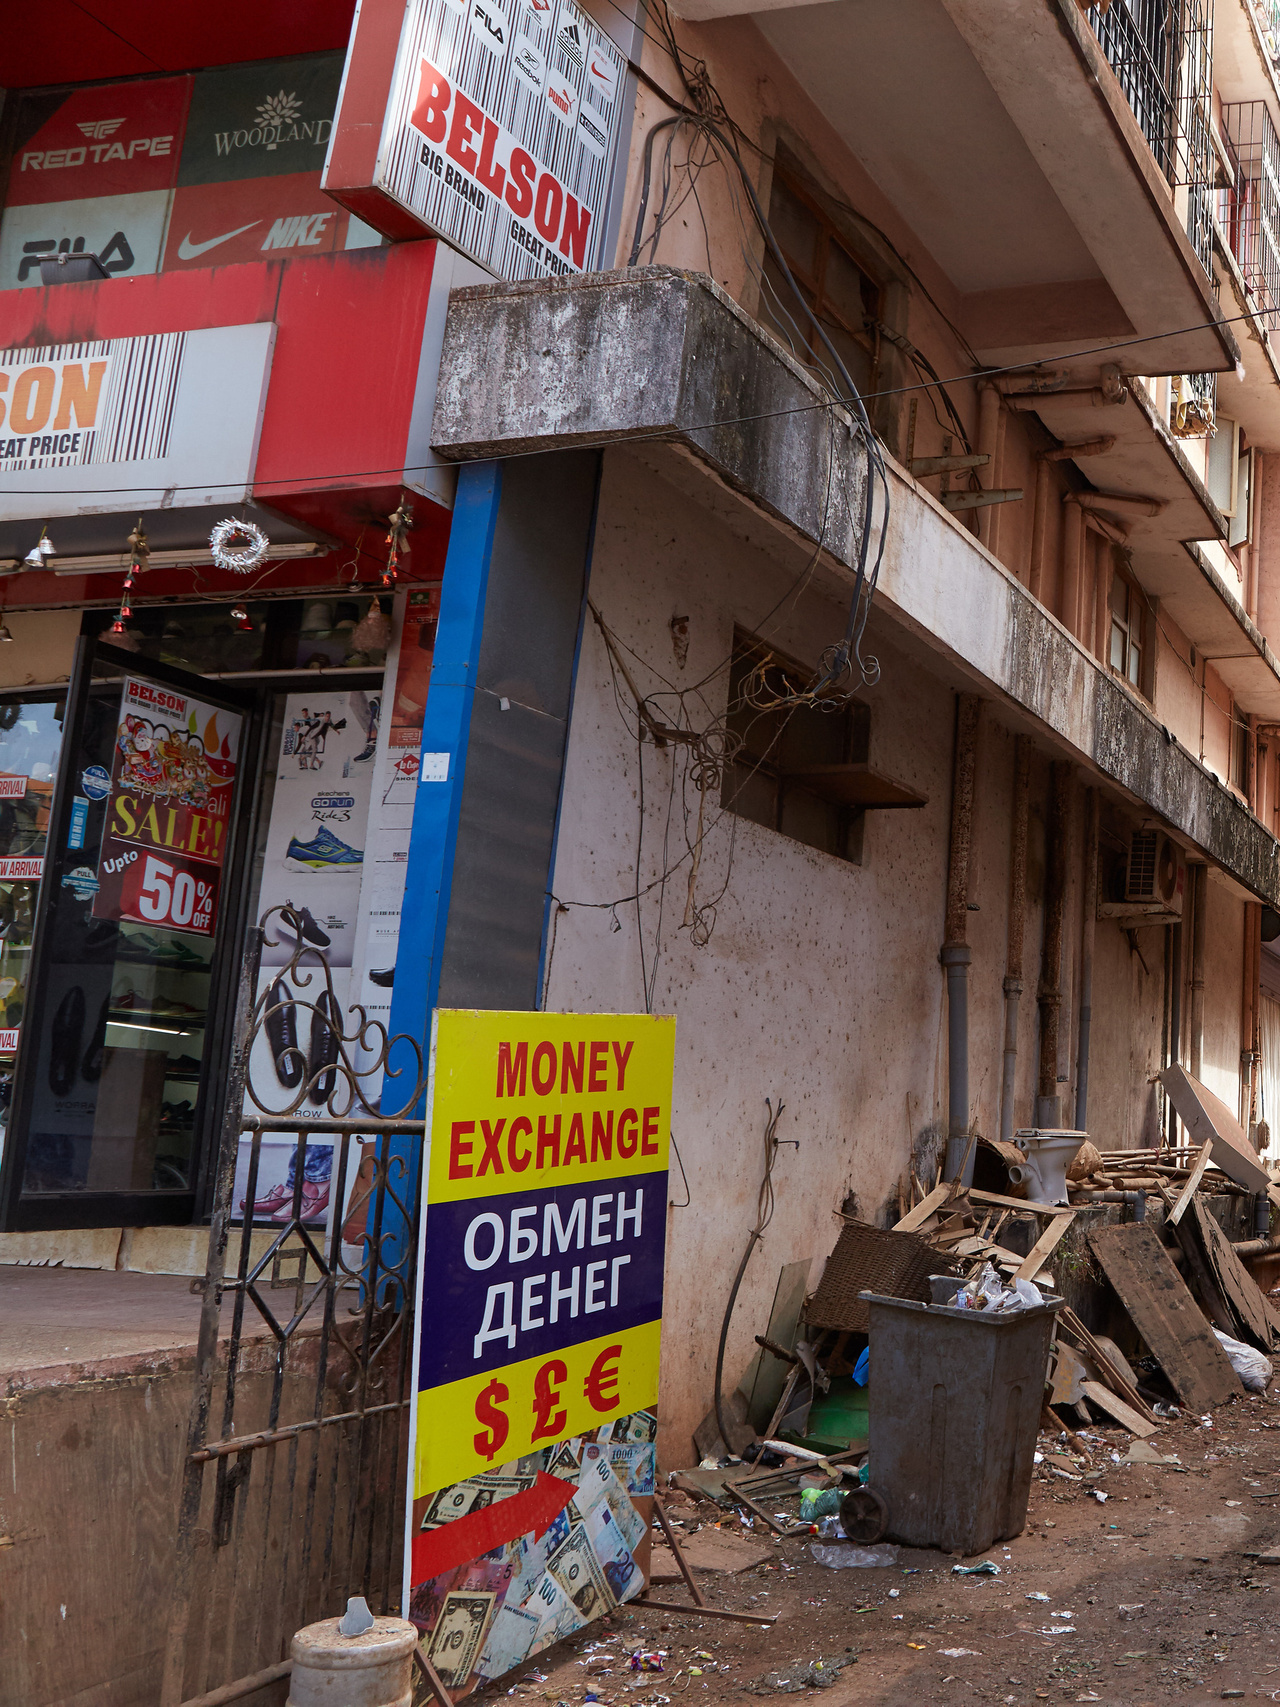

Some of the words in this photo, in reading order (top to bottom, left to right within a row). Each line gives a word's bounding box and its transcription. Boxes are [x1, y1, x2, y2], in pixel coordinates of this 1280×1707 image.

[474, 4, 504, 45] FILA
[559, 30, 584, 58] adidas
[514, 56, 542, 88] Reebok
[548, 89, 569, 116] PUMA
[214, 119, 334, 157] WOODLAND
[411, 57, 592, 270] BELSON
[420, 143, 444, 179] BIG
[444, 164, 486, 212] BRAND
[261, 212, 333, 251] NIKE
[511, 219, 544, 260] GREAT
[544, 248, 579, 276] PRIC
[29, 433, 81, 456] PRICE
[128, 682, 186, 713] BELSON
[110, 795, 223, 859] SALE!
[9, 861, 42, 876] ARRIVAL
[102, 850, 139, 874] Upto
[193, 912, 210, 929] OFF
[495, 1040, 635, 1098] MONEY
[448, 1106, 660, 1180] EXCHANGE
[464, 1188, 644, 1271] ОБМЕН
[473, 1254, 631, 1359] ДЕНЕГ
[473, 1378, 509, 1462] $
[531, 1359, 567, 1444] £
[583, 1345, 622, 1412] €
[596, 1458, 611, 1482] 100
[612, 1449, 633, 1460] 1000
[503, 1564, 513, 1580] 5
[609, 1550, 635, 1583] 20
[538, 1578, 558, 1606] 100
